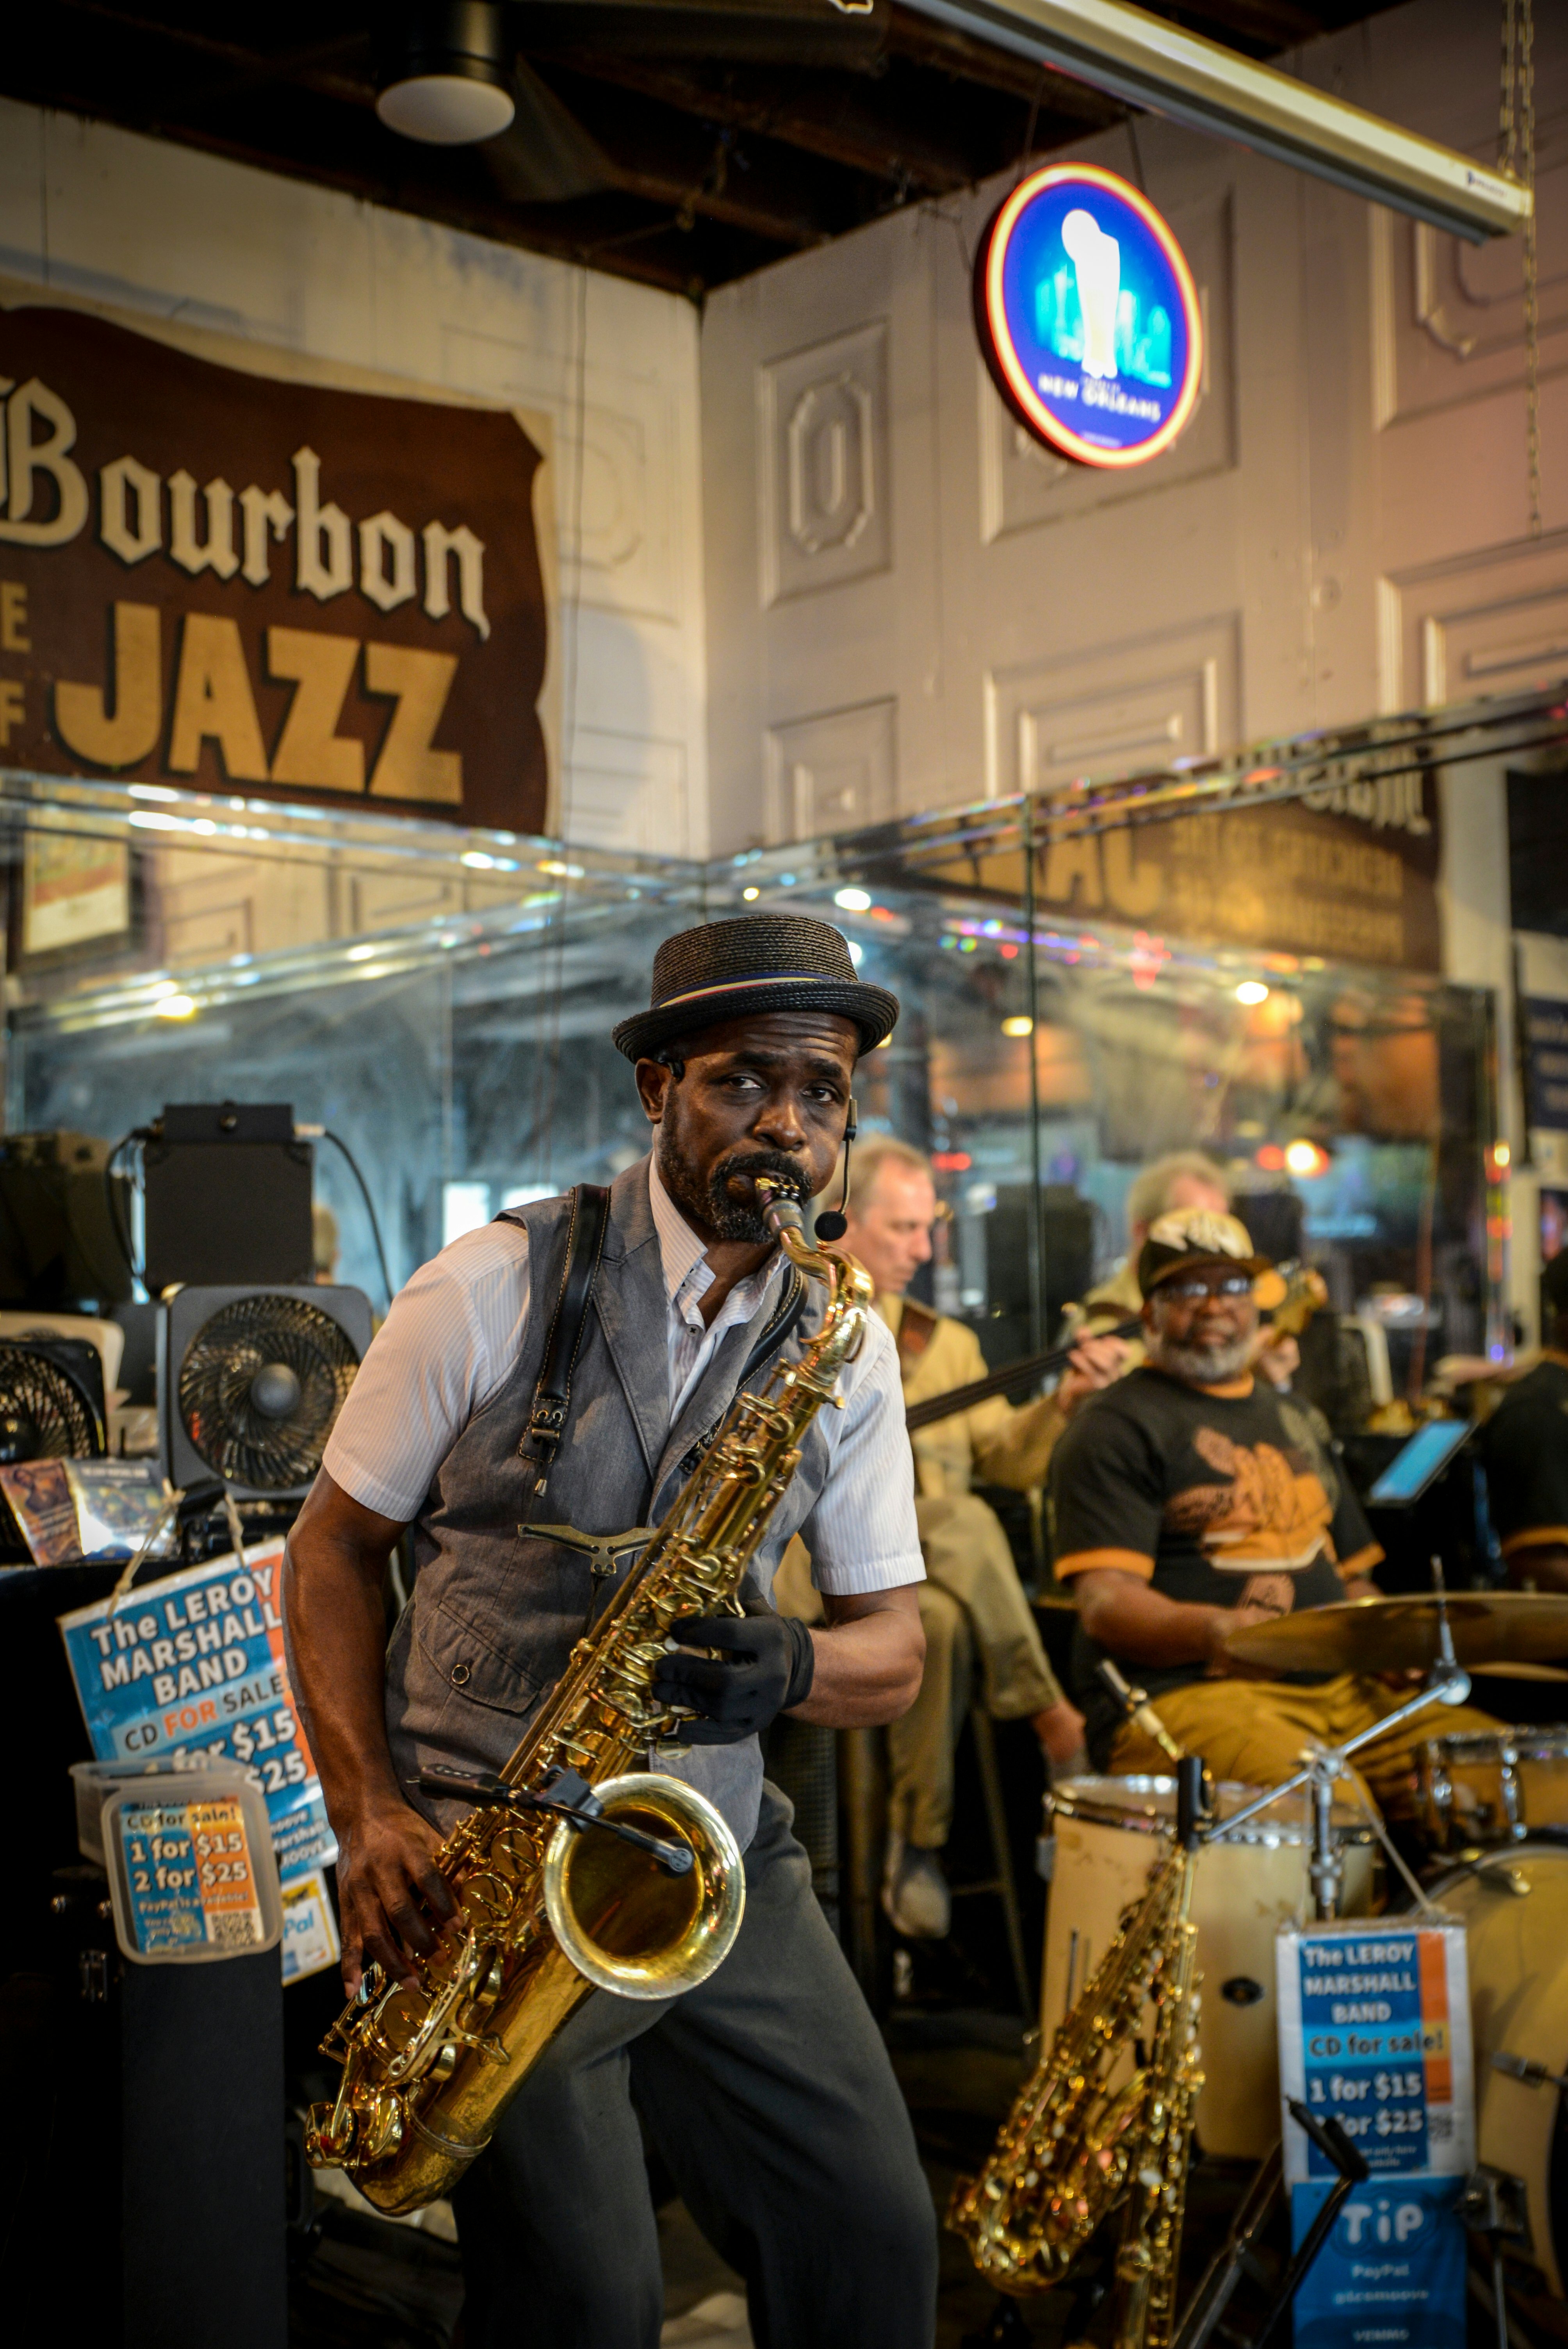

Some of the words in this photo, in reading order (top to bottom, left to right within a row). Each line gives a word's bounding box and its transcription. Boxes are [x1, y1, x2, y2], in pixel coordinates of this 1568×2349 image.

[1039, 373, 1079, 401] NEW
[0, 377, 490, 640] Bourbon
[54, 600, 464, 806] JAZZ
[91, 1615, 159, 1657] The
[164, 1566, 273, 1631] LEROY
[99, 1601, 282, 1691] MARSHALL
[153, 1649, 248, 1706] BAND
[124, 1724, 158, 1752] CD
[163, 1699, 218, 1738] FOR
[223, 1674, 285, 1714] SALE
[232, 1709, 297, 1761] $15
[244, 1750, 307, 1795] $25
[127, 1814, 153, 1829] CD
[158, 1811, 186, 1828] for
[192, 1807, 235, 1823] sale!
[131, 1841, 147, 1863] 1
[151, 1836, 191, 1861] for
[196, 1832, 243, 1858] $15
[134, 1869, 151, 1893] 2
[156, 1865, 195, 1890] for
[202, 1861, 248, 1887] $25
[1304, 1944, 1343, 1967] The
[1345, 1941, 1416, 1965] LEROY
[1303, 1971, 1417, 1996] MARSHALL
[1331, 2002, 1392, 2025] BAND
[1308, 2035, 1341, 2058] CD
[1348, 2032, 1383, 2055] for
[1388, 2030, 1444, 2053] sale!
[1309, 2078, 1326, 2103] 1
[1329, 2073, 1371, 2101] for
[1374, 2072, 1422, 2101] $15
[1375, 2108, 1424, 2137] $25
[1341, 2199, 1424, 2245] TiP
[1351, 2263, 1409, 2281] PayPal
